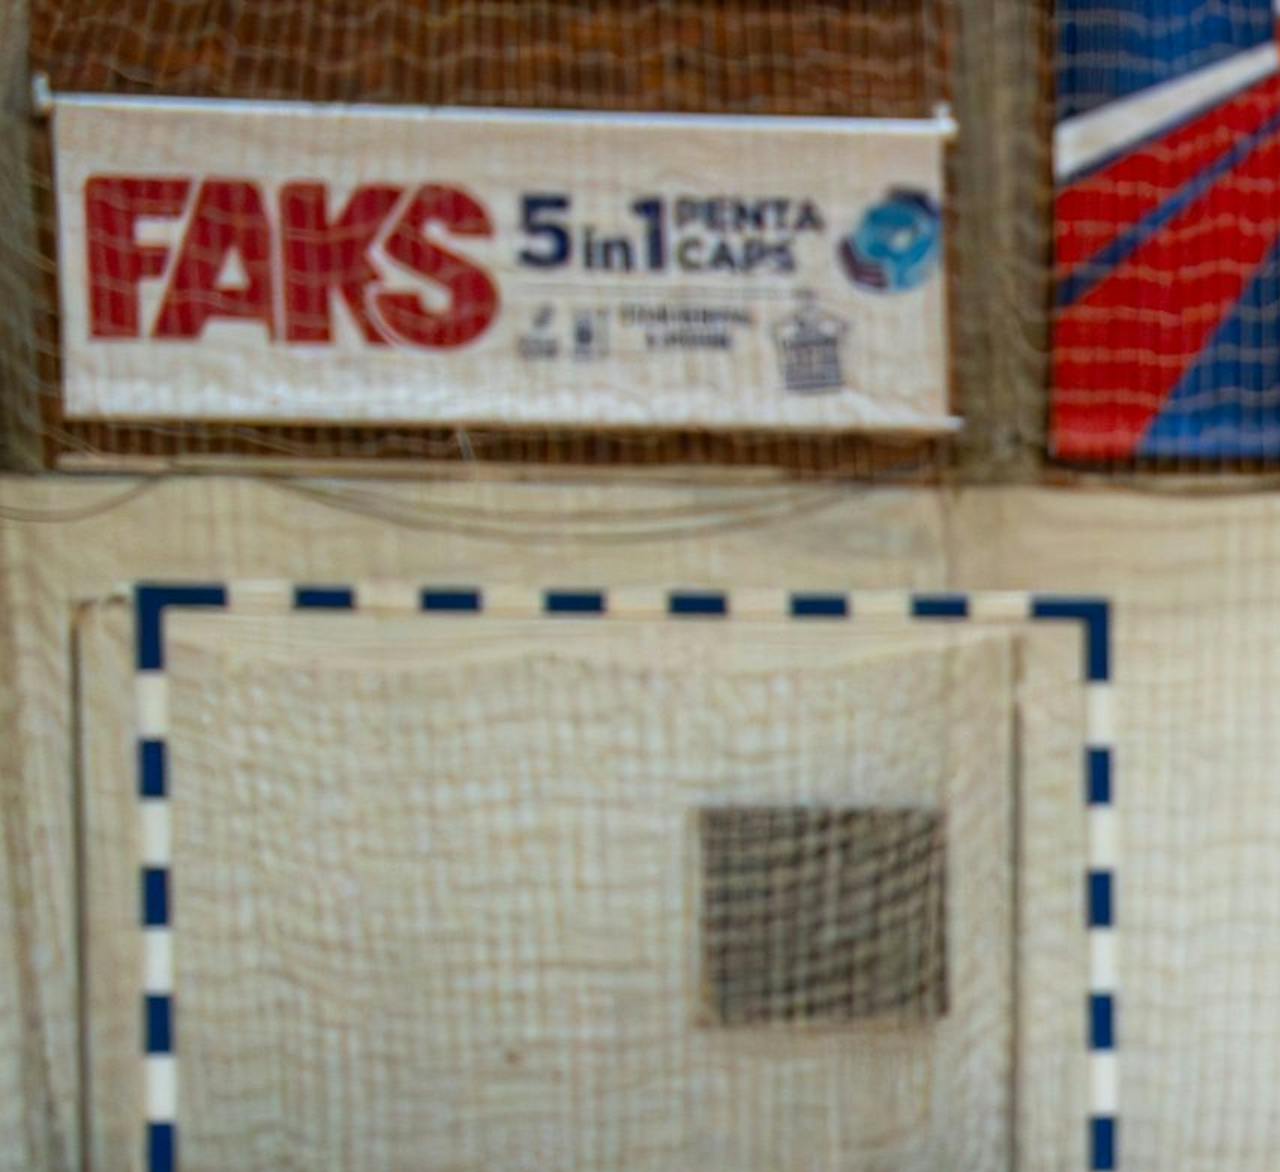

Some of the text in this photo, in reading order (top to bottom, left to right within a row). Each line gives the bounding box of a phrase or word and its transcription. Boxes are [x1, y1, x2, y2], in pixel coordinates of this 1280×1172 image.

[676, 197, 824, 231] PENTA
[86, 176, 499, 350] FAKS
[677, 238, 796, 271] CAPS
